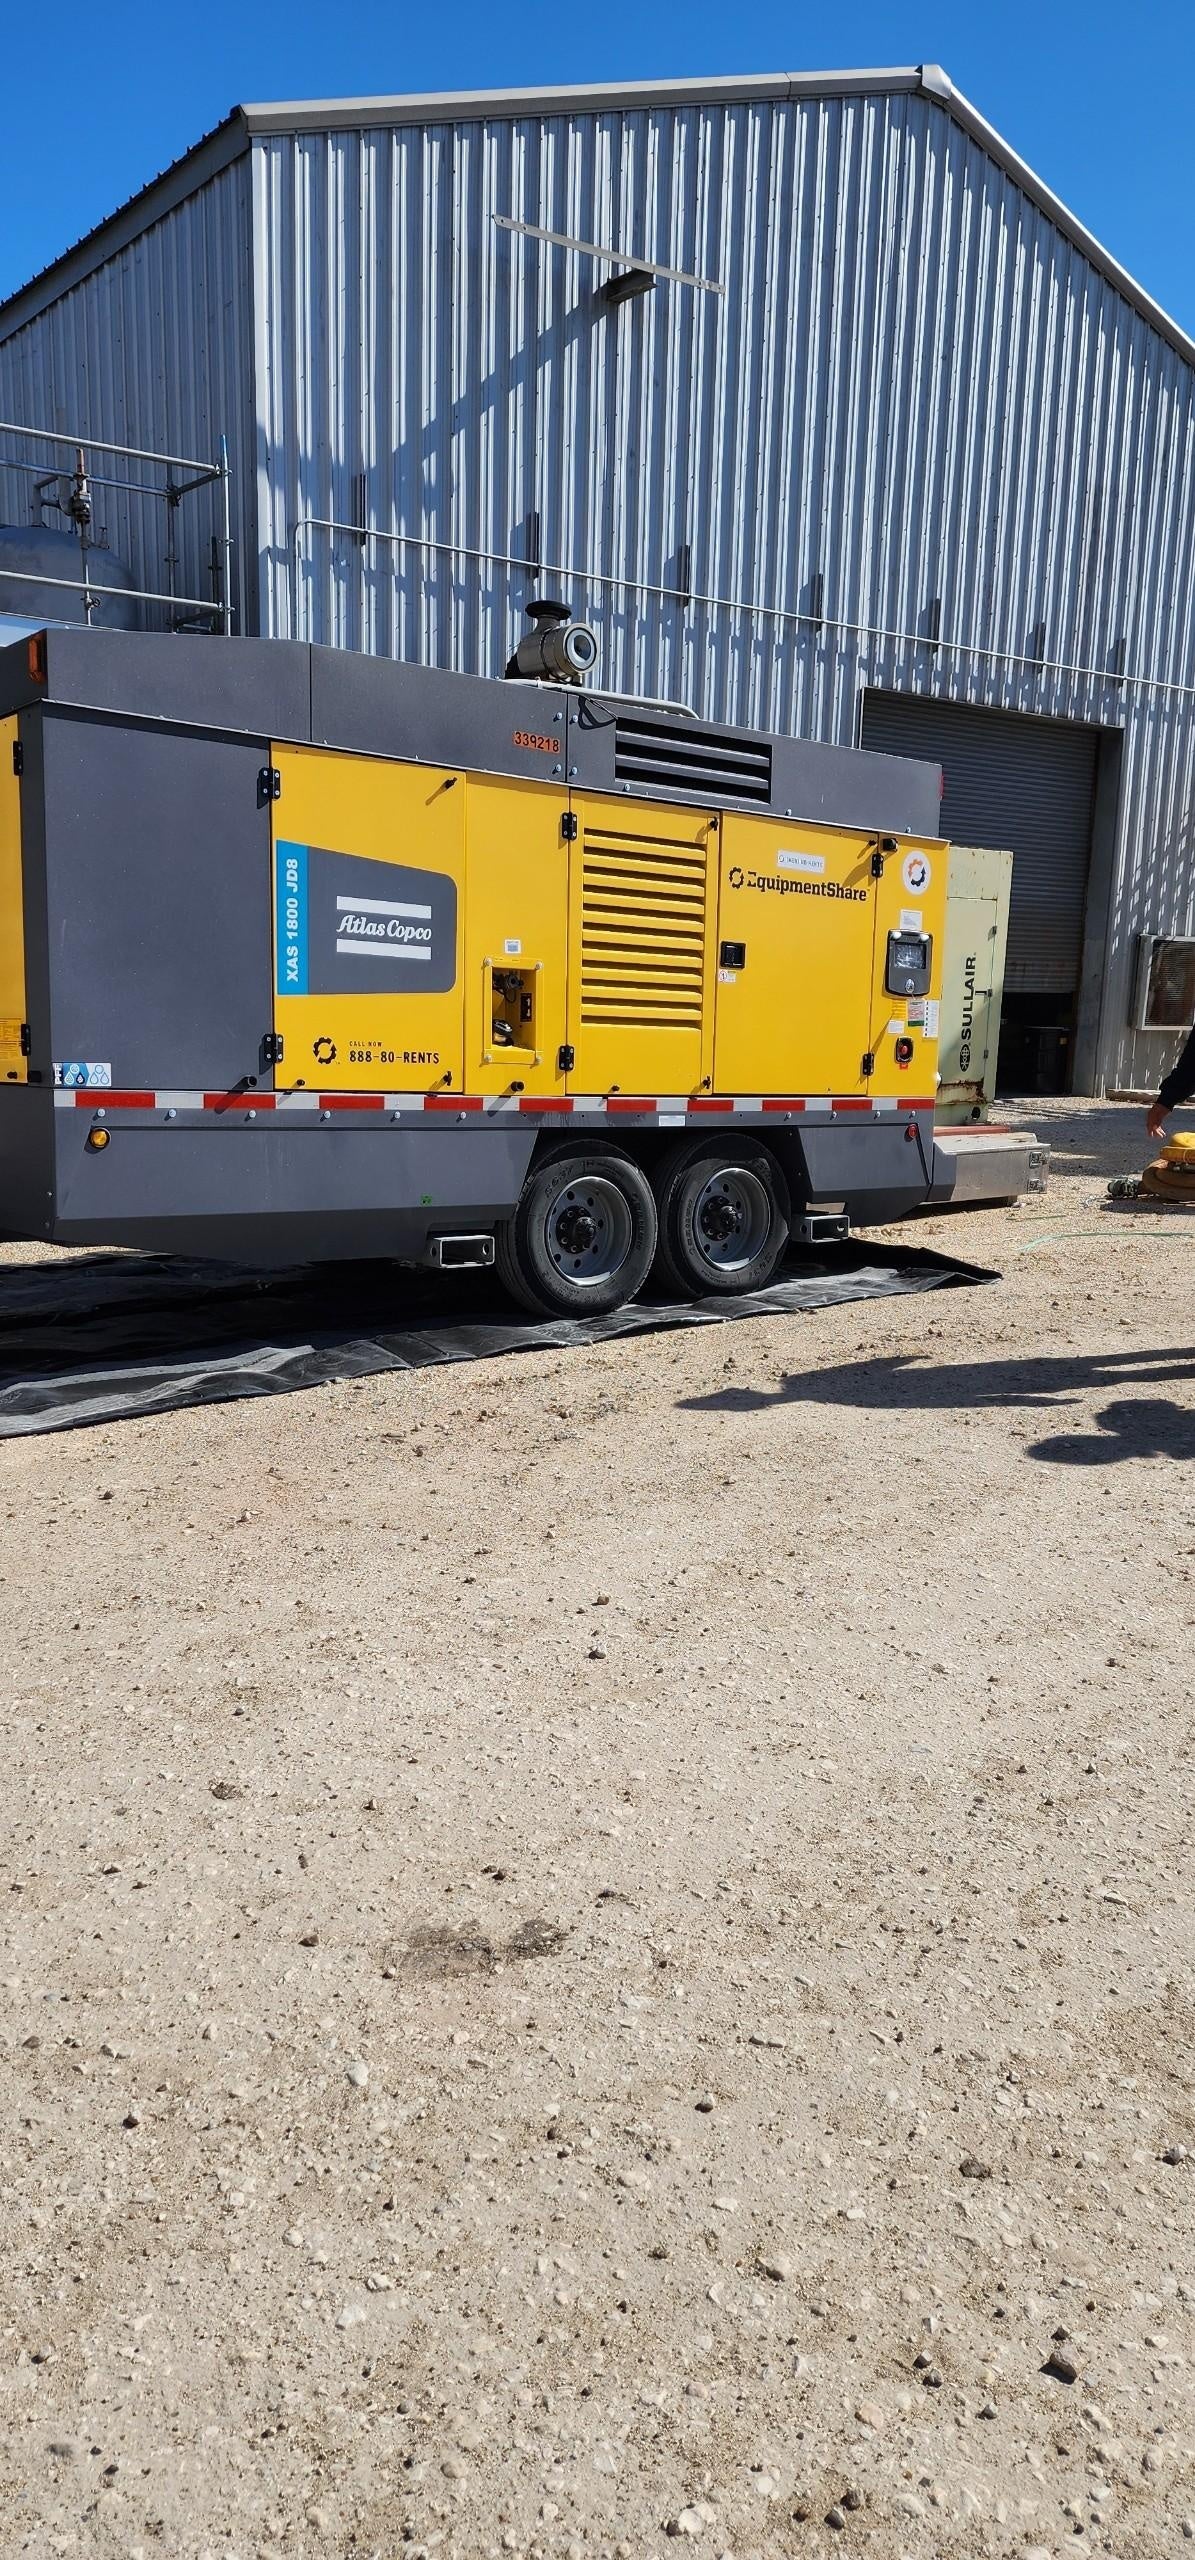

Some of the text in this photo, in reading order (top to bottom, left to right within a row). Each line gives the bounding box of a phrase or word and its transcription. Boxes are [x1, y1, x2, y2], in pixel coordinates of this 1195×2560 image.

[515, 731, 559, 752] 339218
[747, 870, 867, 902] EquipmentShare
[286, 858, 298, 983] XAS 1800 JD8
[336, 914, 432, 943] Atlas Copco
[961, 955, 977, 1040] SULLAIR
[349, 1050, 440, 1064] 888-80-RENTS
